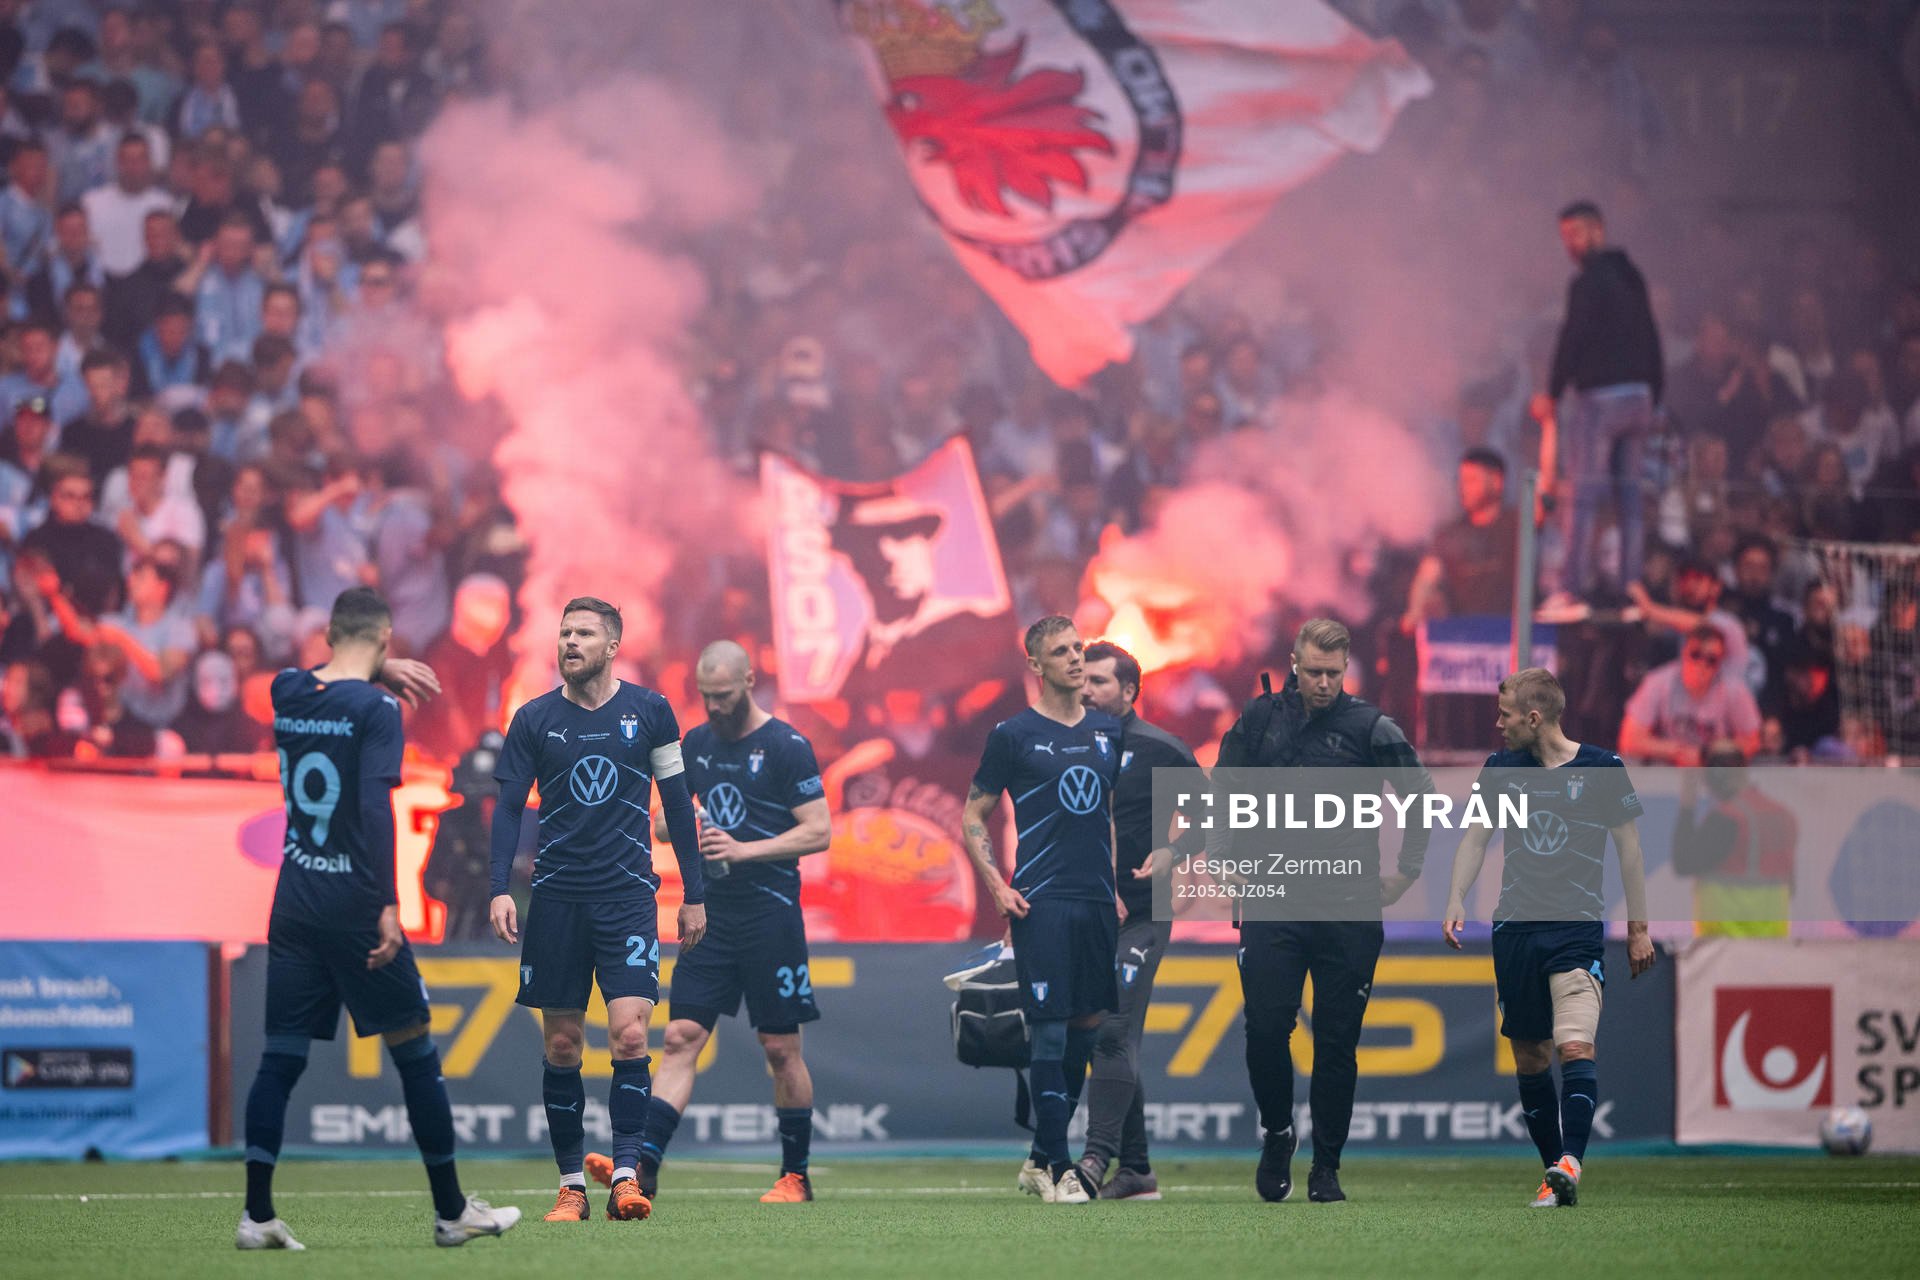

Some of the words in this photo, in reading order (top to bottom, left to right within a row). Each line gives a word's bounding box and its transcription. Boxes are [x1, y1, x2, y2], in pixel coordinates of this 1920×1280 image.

[776, 963, 812, 998] 32
[1857, 1064, 1920, 1109] SP
[311, 1104, 515, 1142] SMRT
